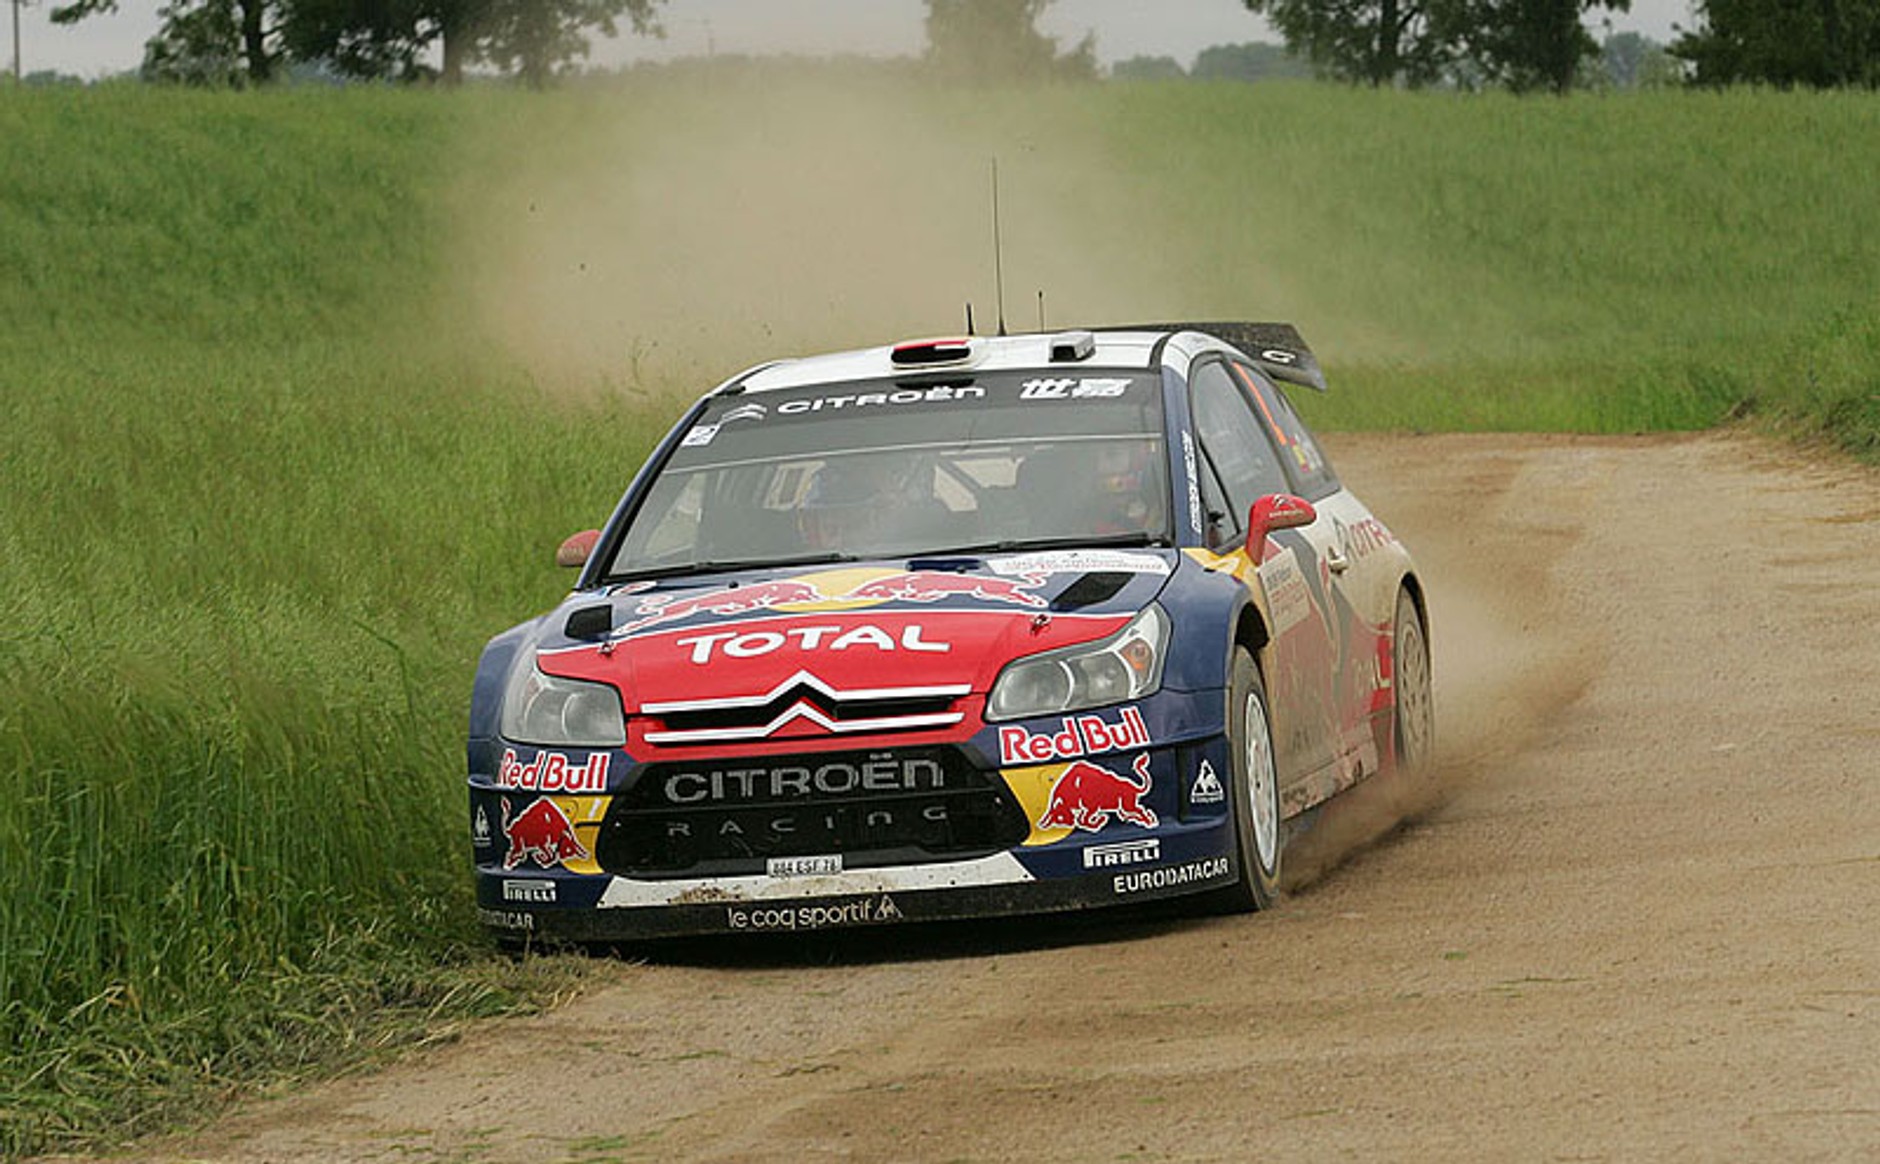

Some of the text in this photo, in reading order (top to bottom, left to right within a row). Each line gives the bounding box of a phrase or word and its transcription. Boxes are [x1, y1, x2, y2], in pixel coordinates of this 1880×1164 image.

[676, 624, 951, 665] TOTAL
[1000, 706, 1152, 764] Red Bull
[499, 749, 611, 791] Red Bull
[664, 752, 944, 803] CITROËN
[666, 806, 947, 837] RACING
[1083, 839, 1160, 868] PIRELLI
[503, 879, 556, 901] PIRELLI
[1114, 857, 1229, 894] EURODATACAR
[728, 899, 873, 931] le coq sportif
